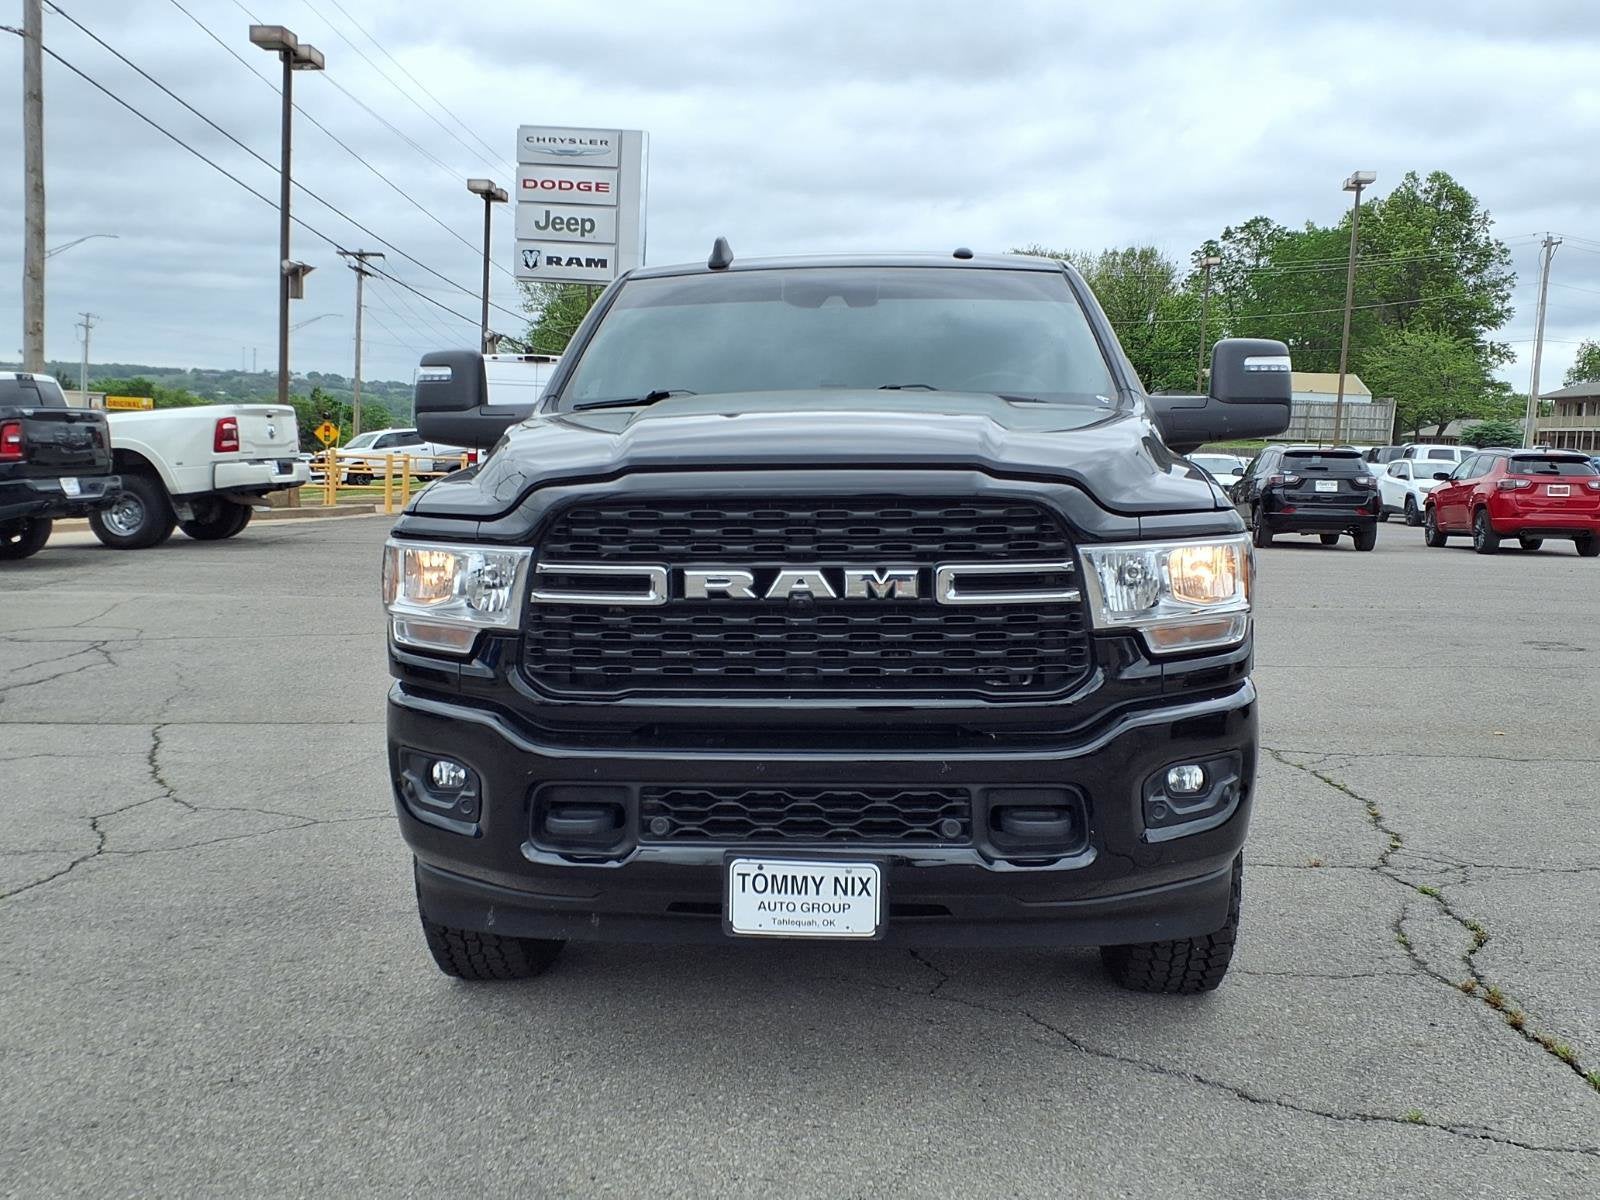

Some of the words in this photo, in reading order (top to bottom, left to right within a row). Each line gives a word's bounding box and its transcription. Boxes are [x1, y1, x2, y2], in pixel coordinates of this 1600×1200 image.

[526, 136, 609, 147] CHRYSLER
[522, 178, 610, 193] DODGE
[534, 210, 596, 238] Jeep
[546, 255, 608, 269] RAM
[684, 569, 919, 599] RAM
[737, 872, 825, 896] TOMMY
[833, 876, 872, 897] NIX
[757, 901, 797, 912] AUTO
[800, 902, 851, 914] GROUP
[771, 917, 820, 928] Tahlequah,
[822, 918, 836, 927] OK
